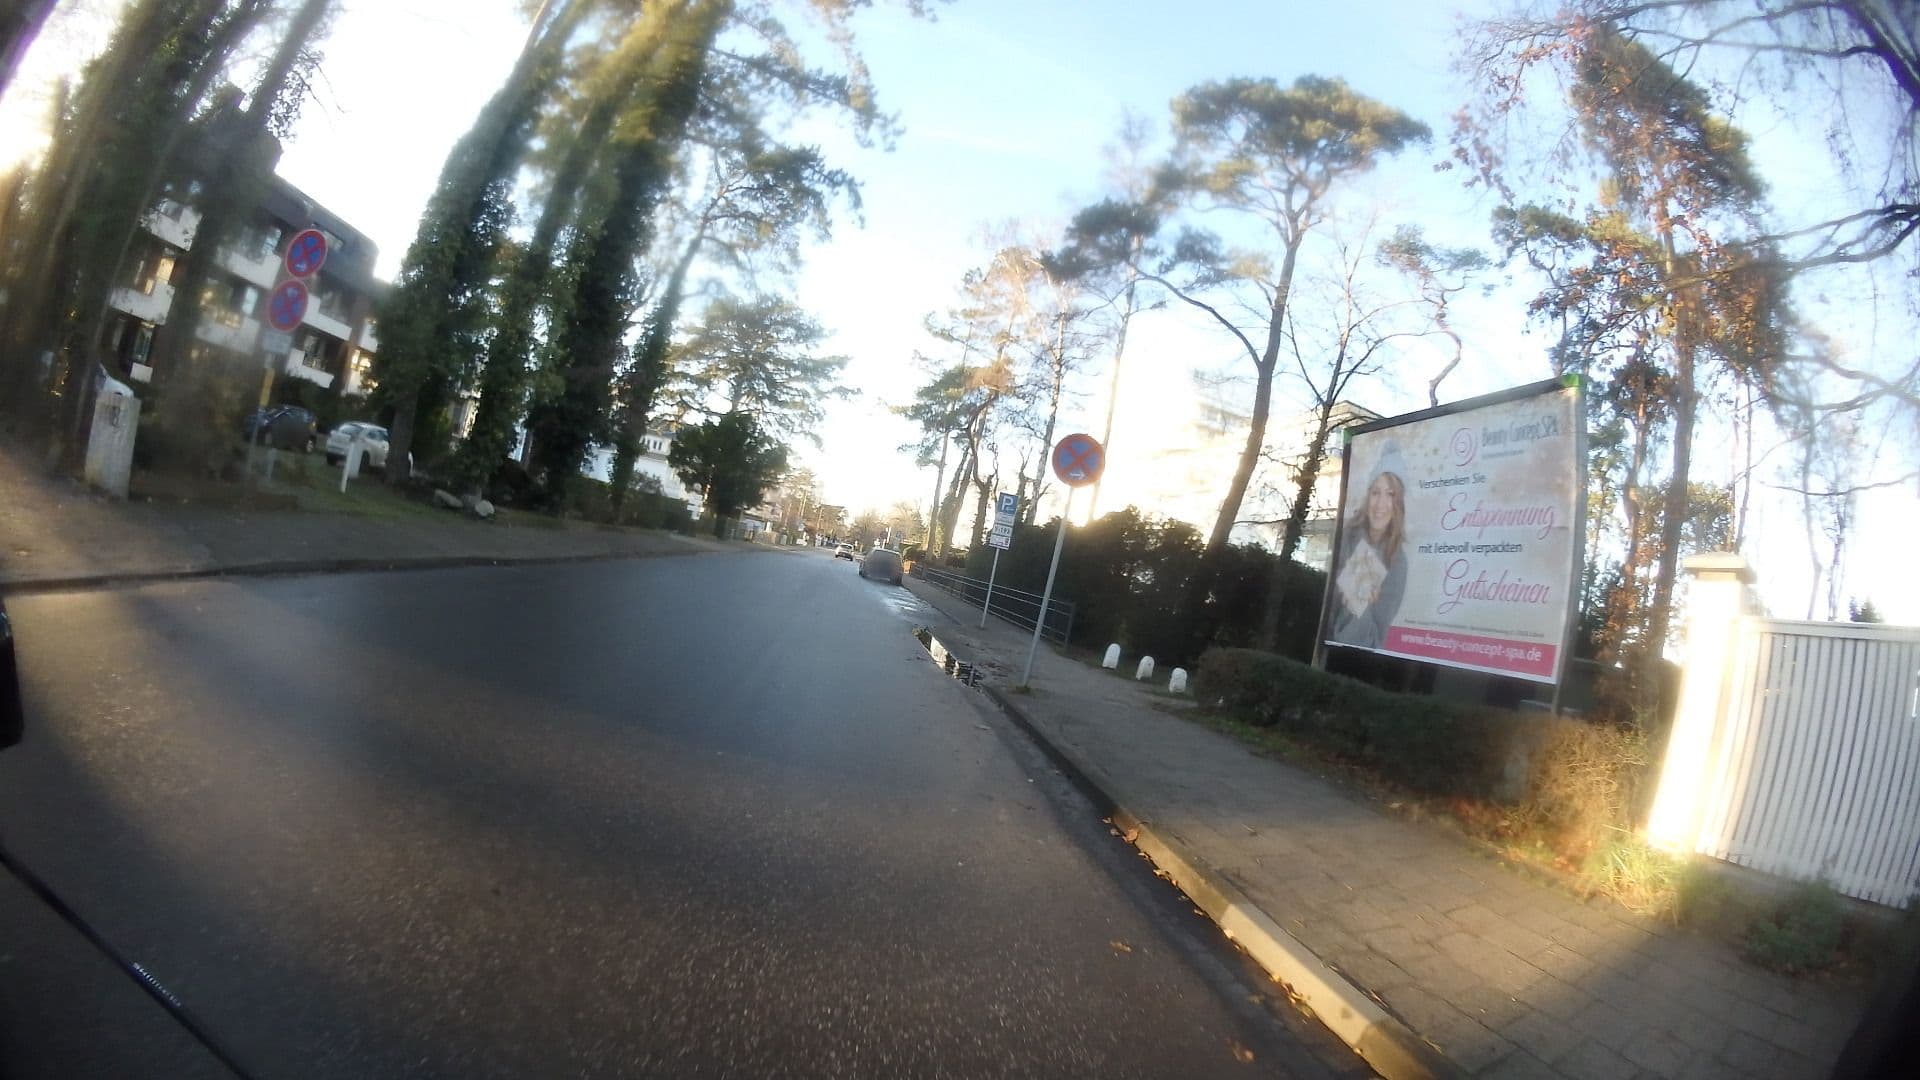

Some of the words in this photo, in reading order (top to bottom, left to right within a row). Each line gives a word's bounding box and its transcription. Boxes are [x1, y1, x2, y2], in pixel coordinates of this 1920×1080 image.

[1418, 475, 1470, 489] Verschenken
[1472, 472, 1487, 485] Sie
[1001, 495, 1014, 511] P
[1441, 492, 1555, 540] Entspannung
[1418, 543, 1432, 554] mit
[1434, 541, 1469, 554] liebevoll
[1471, 540, 1523, 557] verpackten
[1437, 558, 1551, 615] Gutscheinen
[1400, 633, 1543, 662] www.beauty-concept-spa.de
